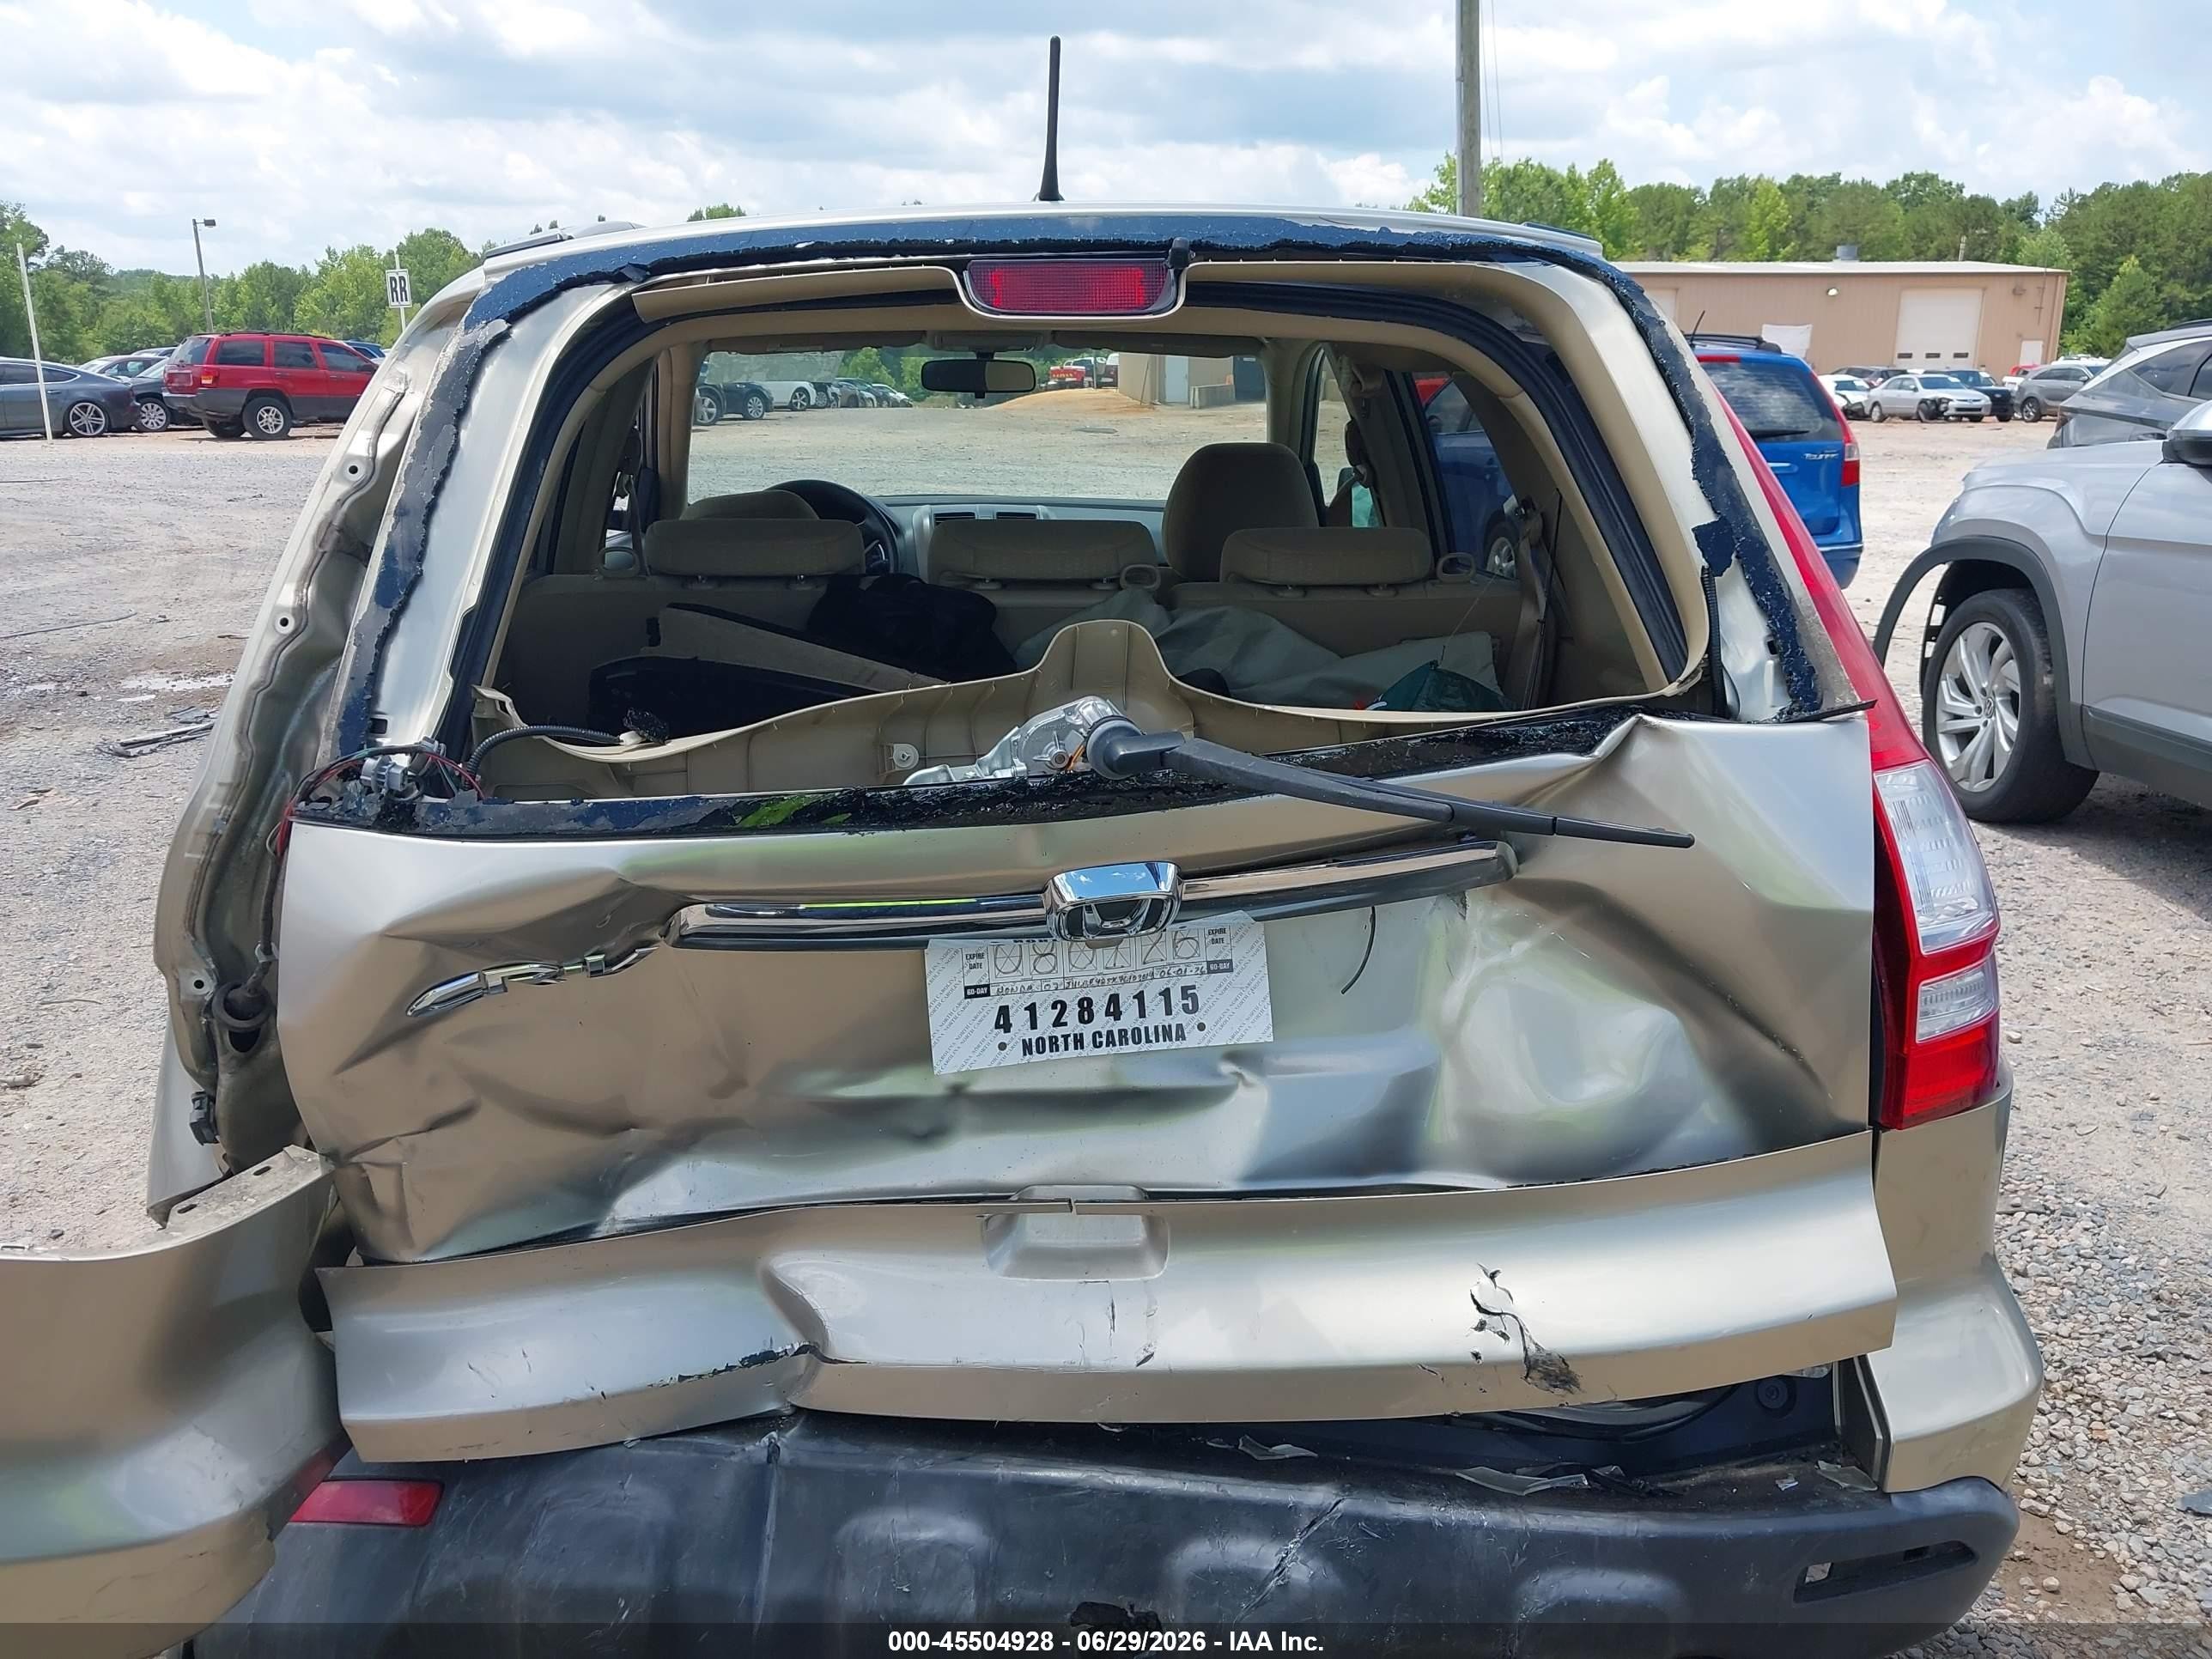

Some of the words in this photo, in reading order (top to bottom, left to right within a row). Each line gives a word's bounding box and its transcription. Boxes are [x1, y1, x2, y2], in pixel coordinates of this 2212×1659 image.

[389, 275, 409, 302] RR
[1207, 927, 1227, 936] EXPIRE
[965, 952, 986, 961] EXPIRE
[966, 988, 988, 996] 60-DAY
[994, 985, 1200, 1034] 41284115
[1022, 1032, 1085, 1056] NORTH
[1091, 1023, 1187, 1049] CAROLINA
